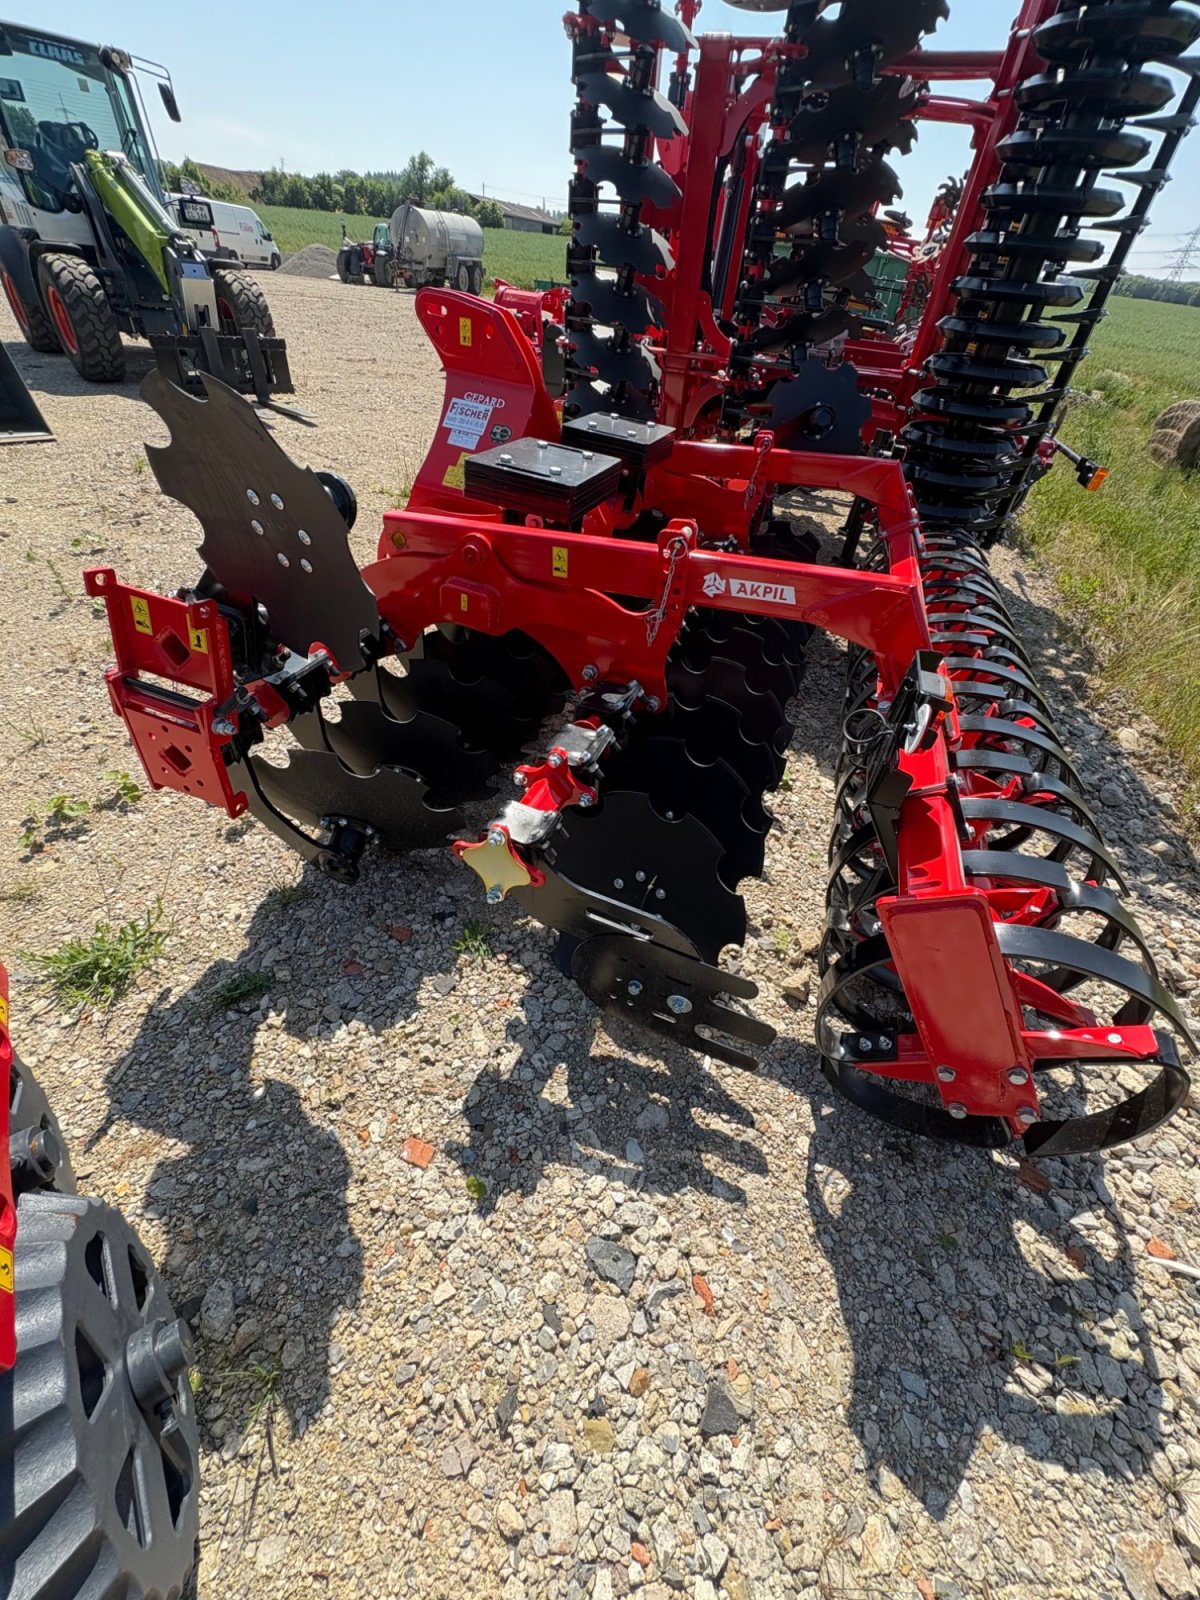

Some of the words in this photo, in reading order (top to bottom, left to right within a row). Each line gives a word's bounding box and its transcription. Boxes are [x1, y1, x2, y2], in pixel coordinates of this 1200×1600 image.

[29, 41, 85, 66] CLAAS
[463, 391, 506, 409] GEPARD
[449, 402, 489, 421] FISCHER
[736, 582, 788, 601] AKPIL
